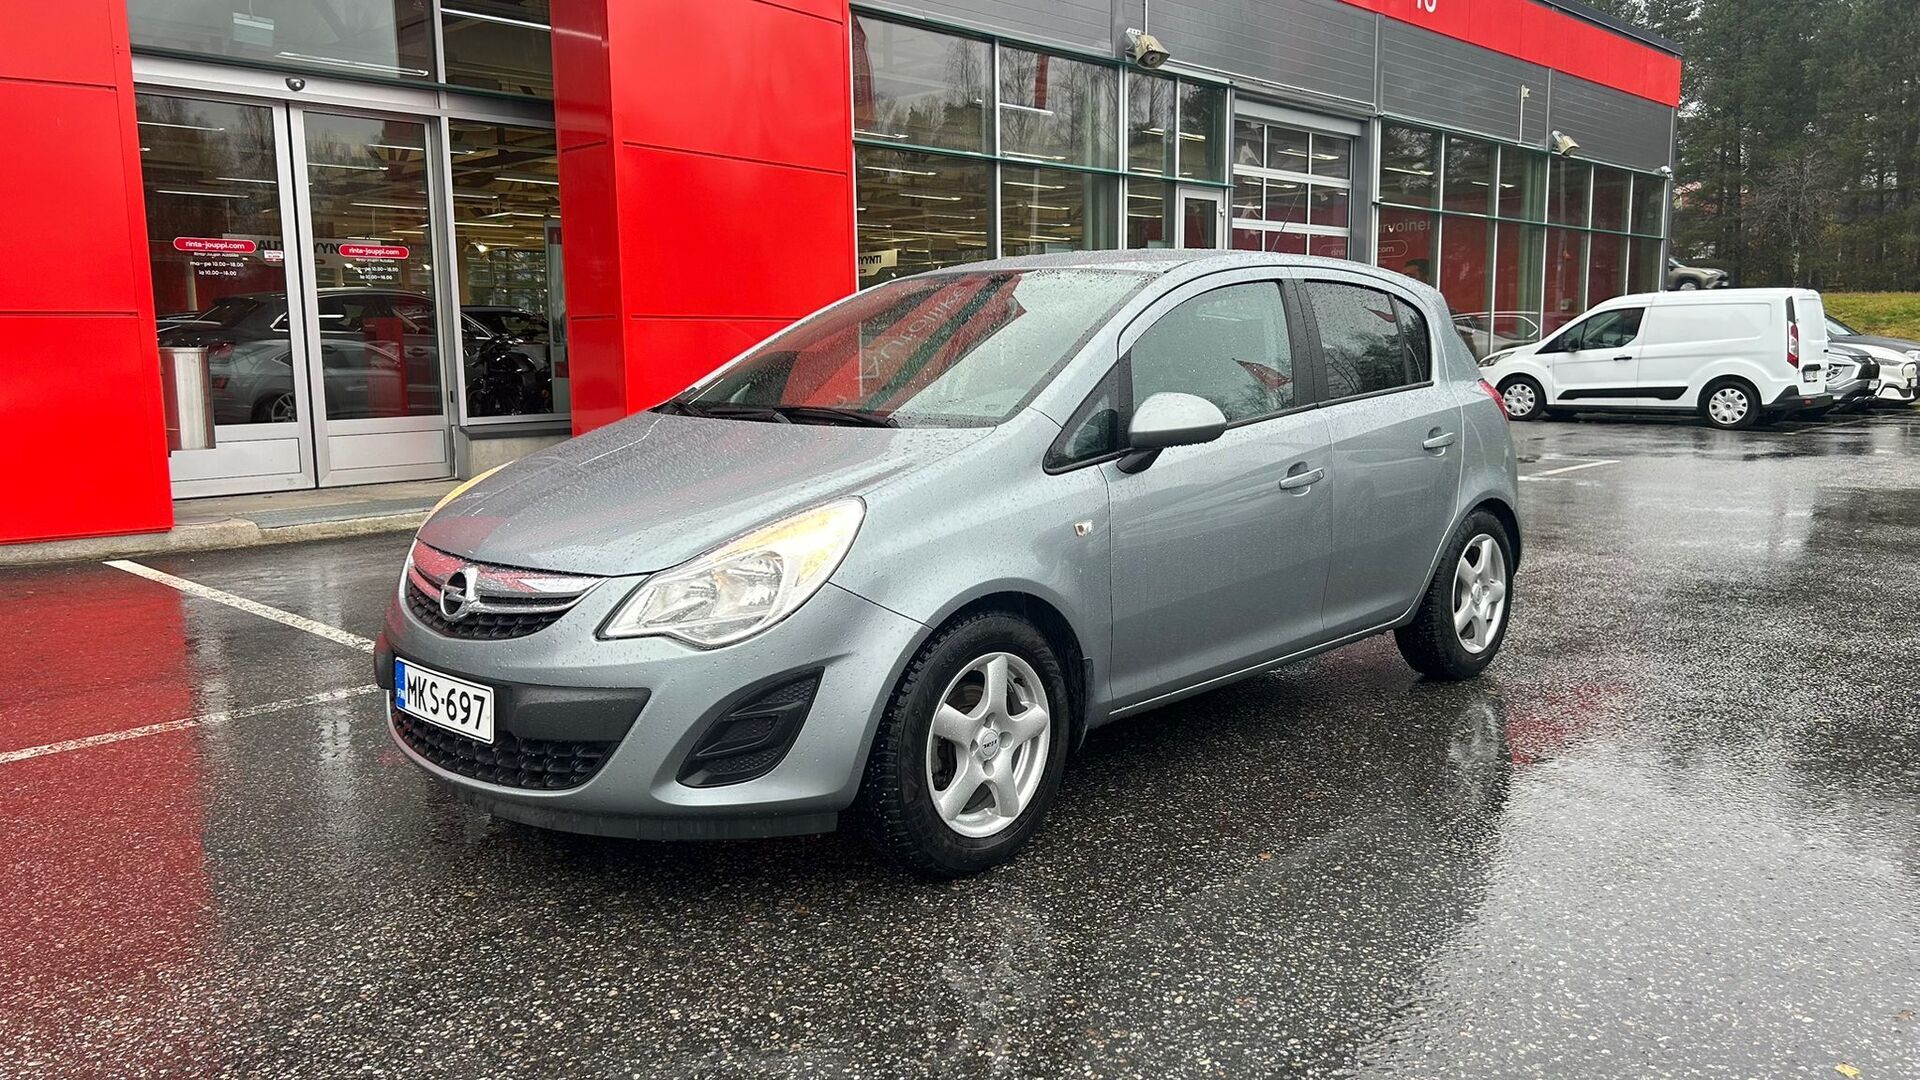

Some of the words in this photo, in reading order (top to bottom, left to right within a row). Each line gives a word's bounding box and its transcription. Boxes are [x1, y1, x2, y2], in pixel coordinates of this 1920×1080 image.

[185, 241, 245, 250] rinta-jouppi.com
[348, 247, 400, 256] rinta-jouppi.com
[859, 255, 882, 265] YYNTI
[407, 671, 486, 730] MKS-697
